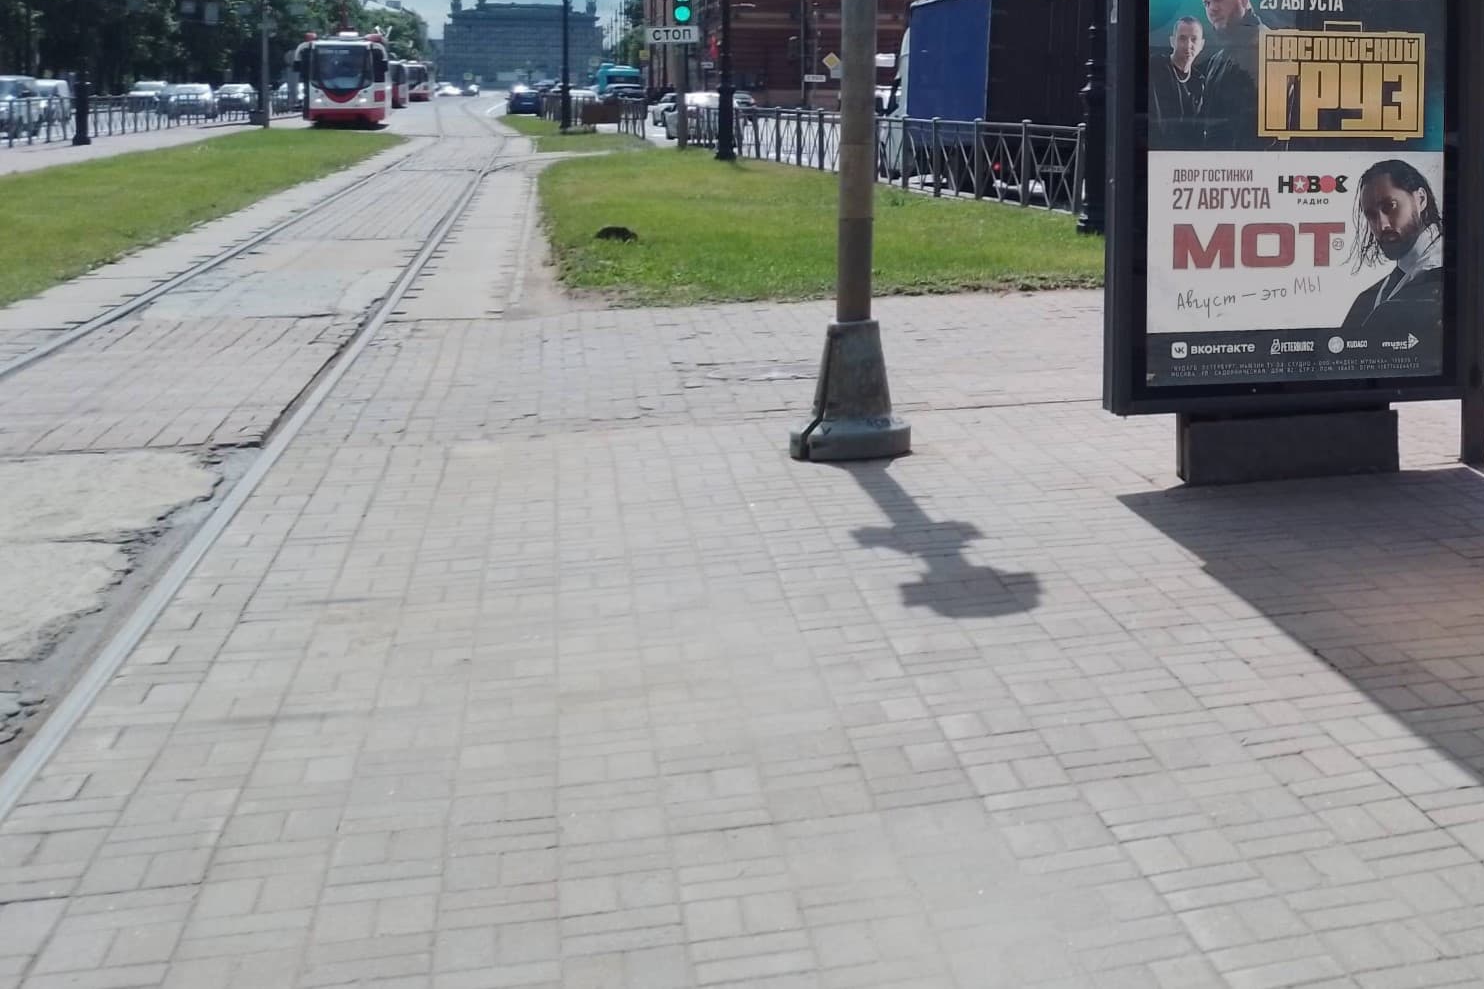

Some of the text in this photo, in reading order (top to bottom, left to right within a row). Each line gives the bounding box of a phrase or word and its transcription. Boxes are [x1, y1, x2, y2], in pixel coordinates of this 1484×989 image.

[652, 29, 692, 41] СТОП
[1265, 61, 1419, 131] ГРУЗ
[1173, 169, 1253, 183] ДВОР ГОСТИНКИ
[1172, 187, 1271, 210] 27 АВГУСТА
[1172, 222, 1346, 270] МОТ
